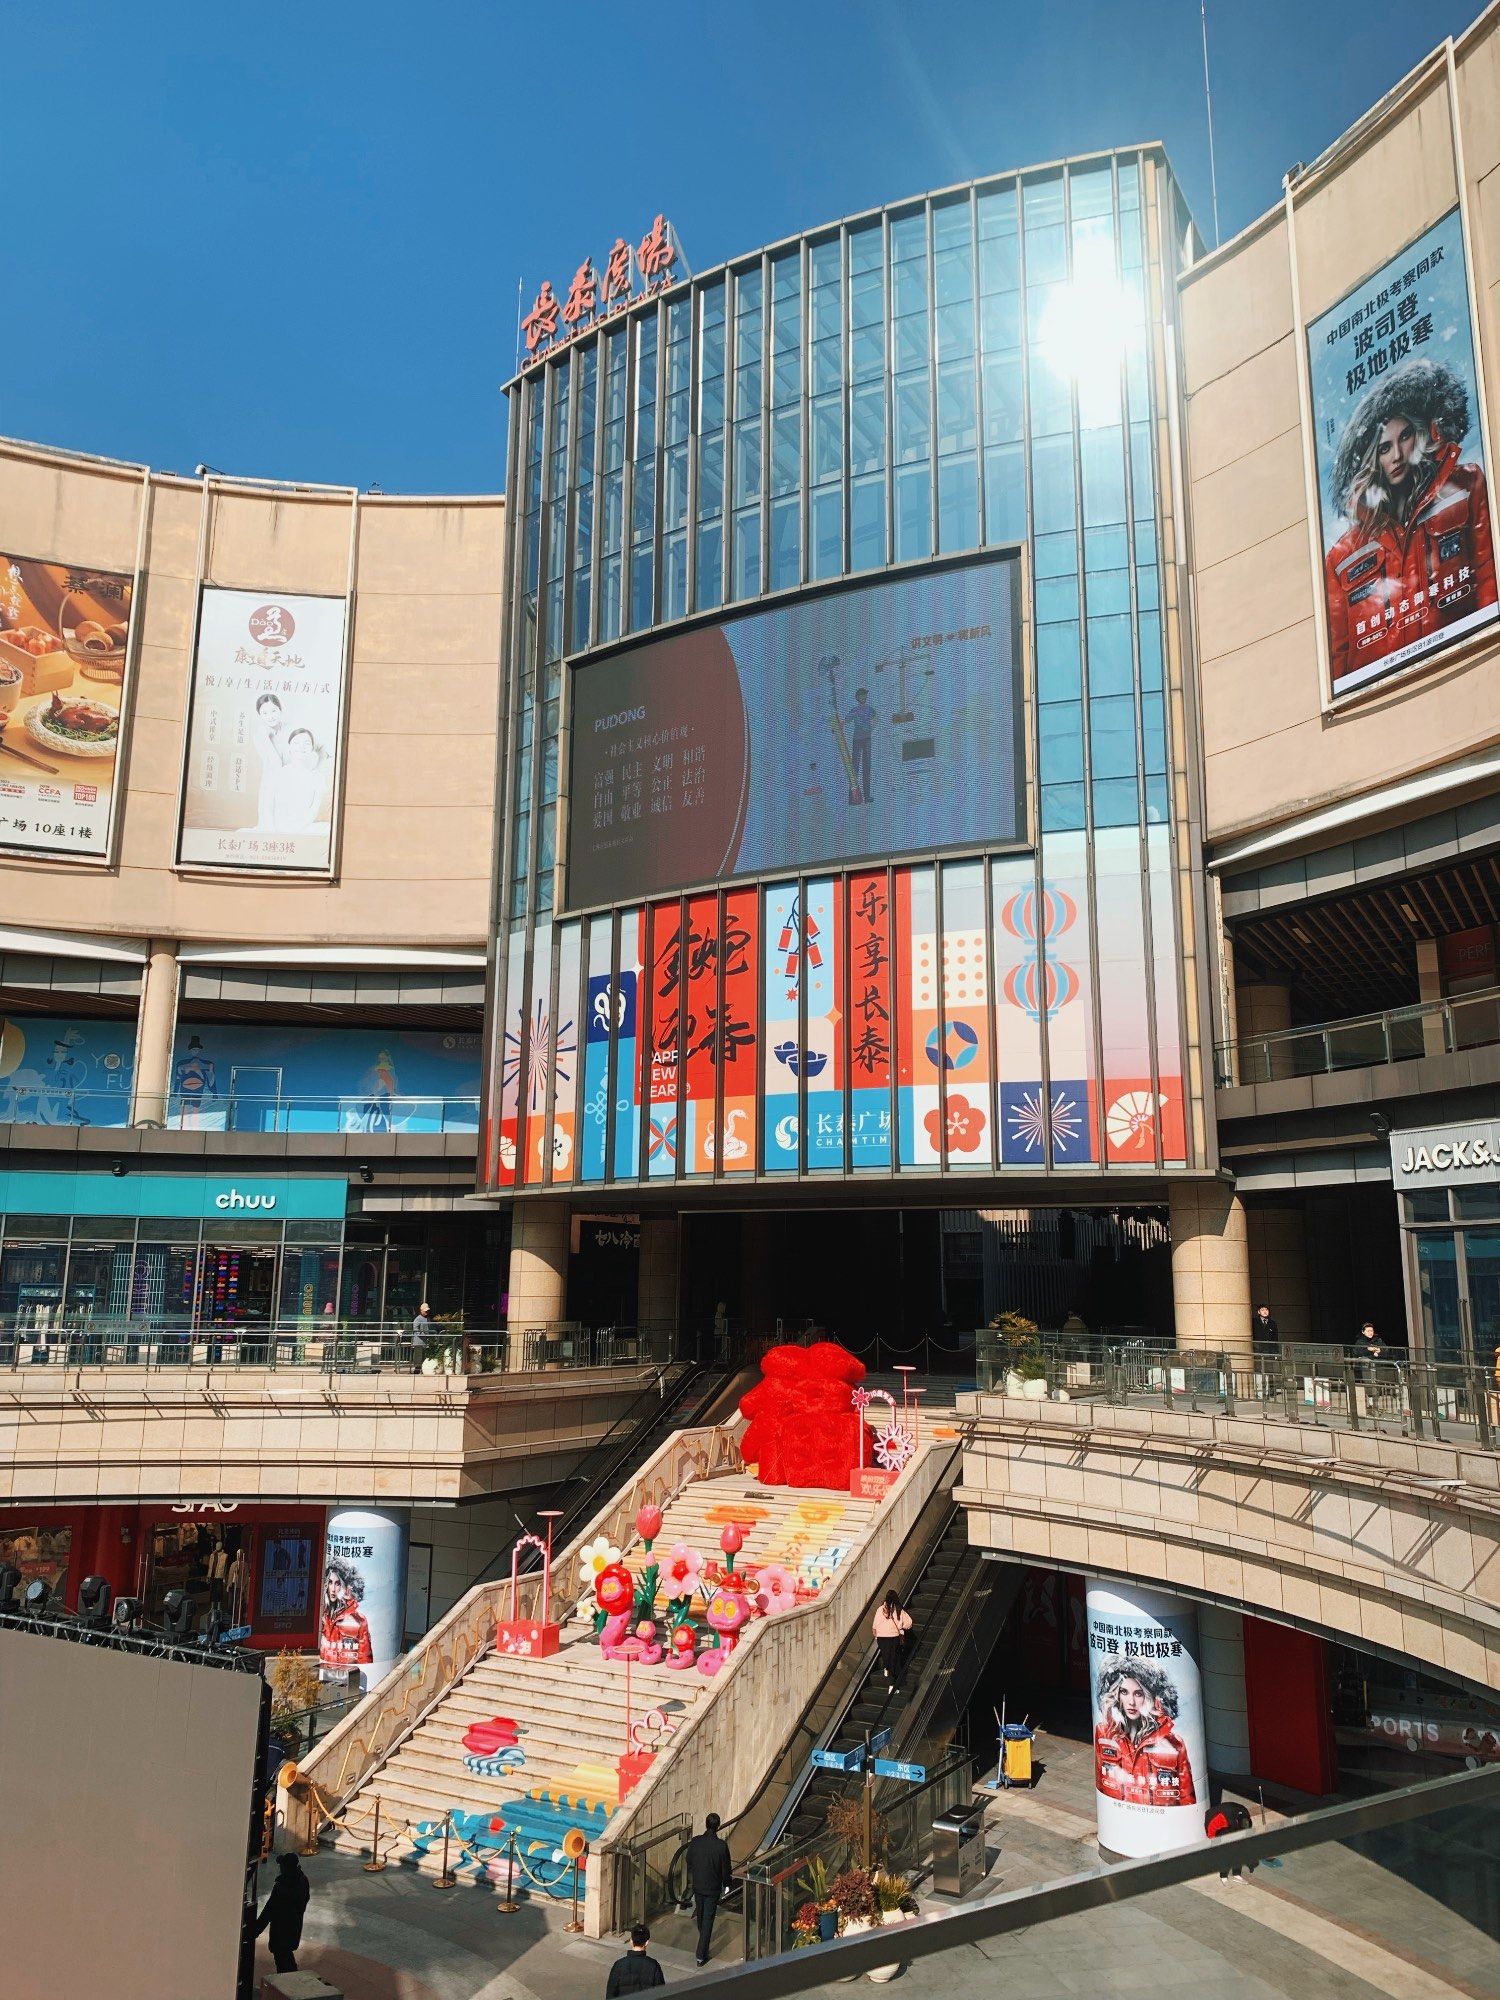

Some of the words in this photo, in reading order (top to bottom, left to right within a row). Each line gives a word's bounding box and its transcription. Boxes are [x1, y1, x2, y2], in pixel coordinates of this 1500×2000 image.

[1326, 246, 1445, 346] 中国南北极考察同款
[1354, 292, 1420, 360] 波司登
[1345, 312, 1434, 395] 极地极寒
[594, 706, 647, 733] PUDONG
[35, 822, 93, 839] 10座1楼
[262, 840, 296, 855] 3座3楼
[851, 881, 890, 1074] 乐享长泰
[640, 1049, 691, 1066] APP
[640, 1067, 677, 1082] EW
[816, 1136, 888, 1147] CHAMTIM
[215, 1188, 277, 1210] chuu
[1093, 1620, 1173, 1639] 中国南北极考察同款
[1124, 1640, 1183, 1659] 极地极寒
